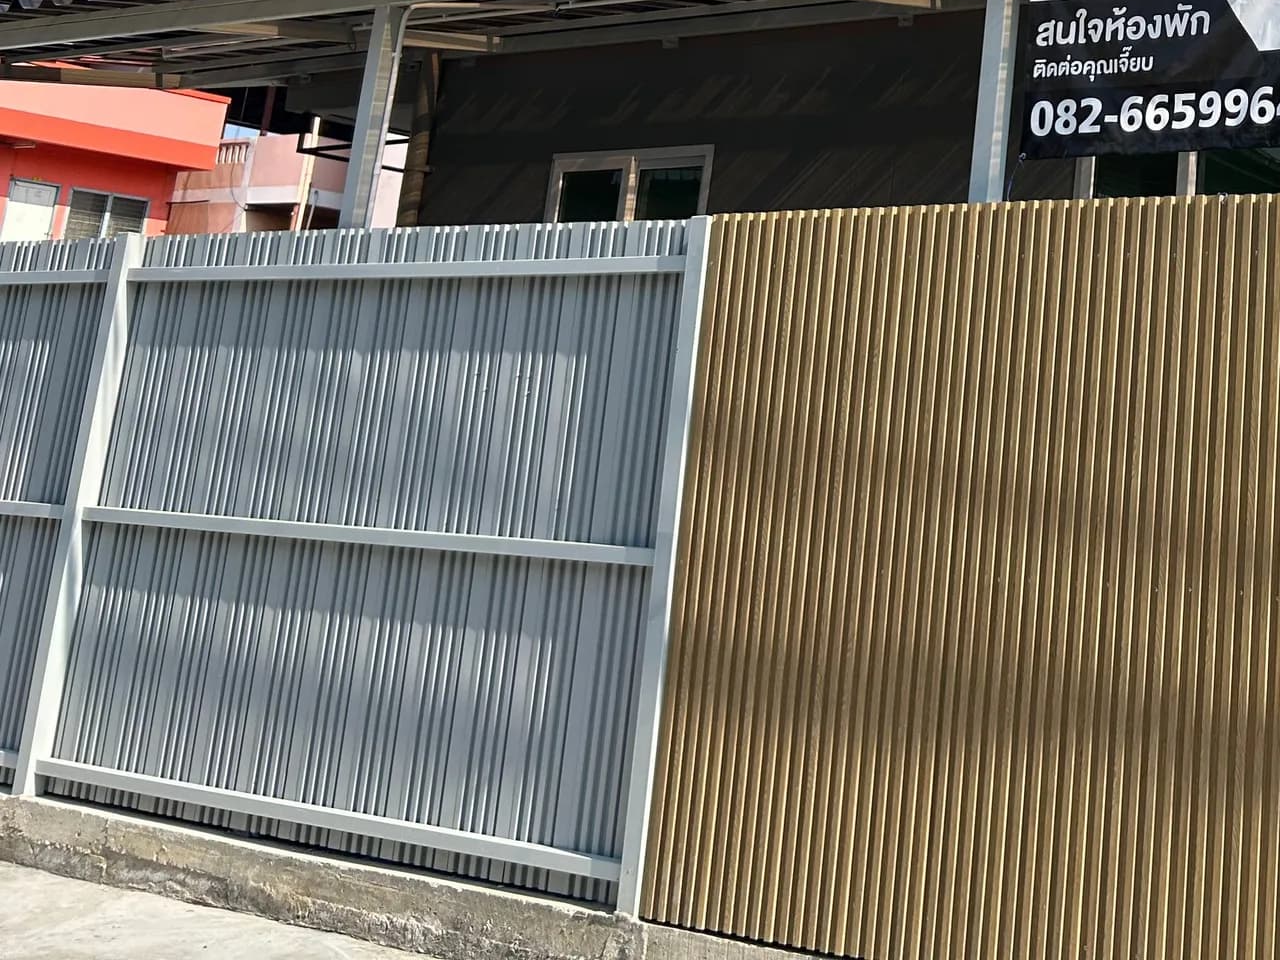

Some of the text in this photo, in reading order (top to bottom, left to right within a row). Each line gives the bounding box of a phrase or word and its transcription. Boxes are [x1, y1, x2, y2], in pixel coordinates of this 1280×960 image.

[1035, 2, 1211, 48] สนใจห้องพัก
[1032, 45, 1154, 83] ติดต่อคุณเจี๊ยบ
